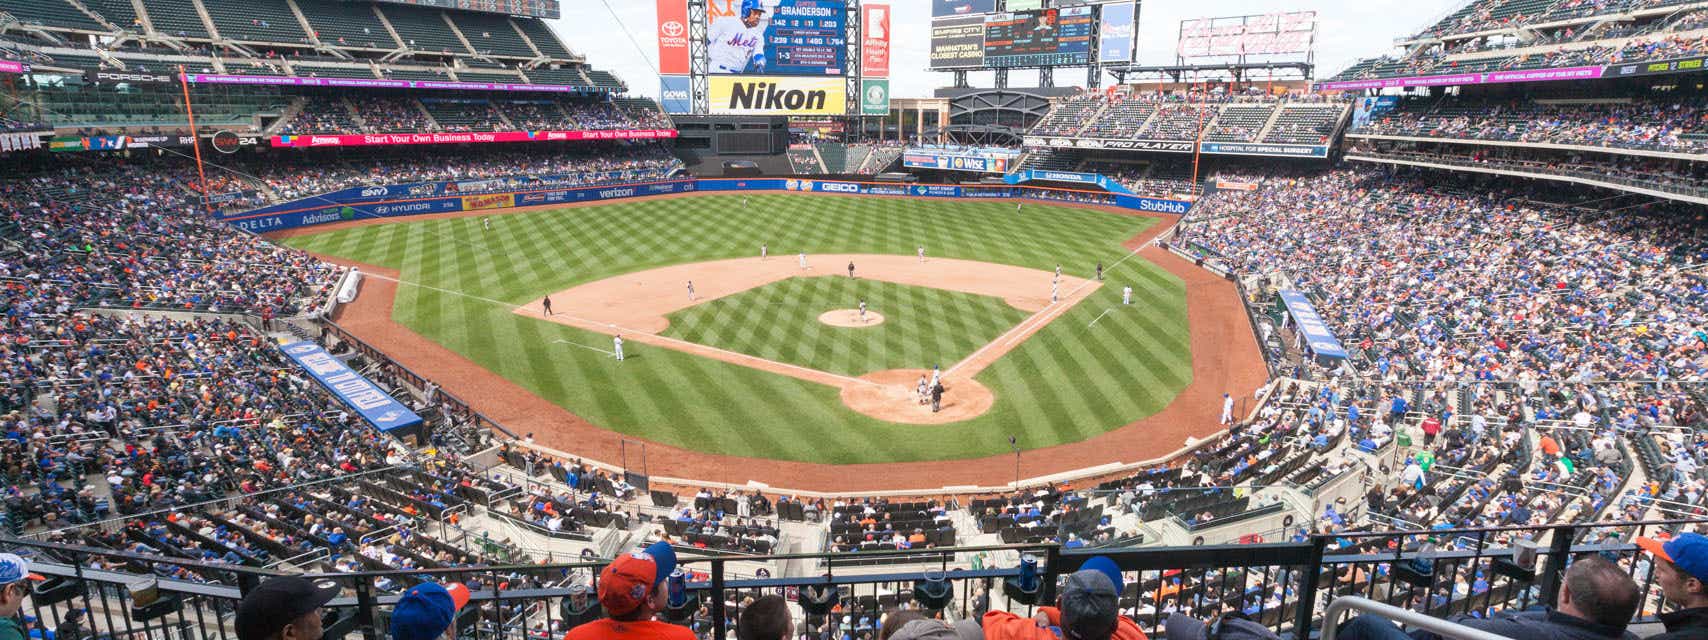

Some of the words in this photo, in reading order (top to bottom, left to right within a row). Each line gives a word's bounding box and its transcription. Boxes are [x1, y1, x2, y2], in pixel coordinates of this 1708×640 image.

[782, 6, 831, 16] GRANDERSON
[931, 51, 958, 60] CLOSEST
[959, 50, 983, 58] CASINO
[97, 72, 170, 82] PORSCHE
[730, 82, 826, 110] Nikon
[240, 138, 258, 146] 24
[311, 136, 340, 146] Amway
[365, 136, 388, 144] Start
[474, 134, 496, 142] Today
[1136, 142, 1191, 150] PLAYER
[964, 158, 984, 170] WISE
[600, 188, 633, 198] verizon
[822, 184, 858, 192] GEICO
[392, 203, 430, 212] HYUNDAI
[1140, 200, 1185, 214] StubHub
[302, 212, 340, 225] Advisors
[240, 218, 282, 230] DELTA
